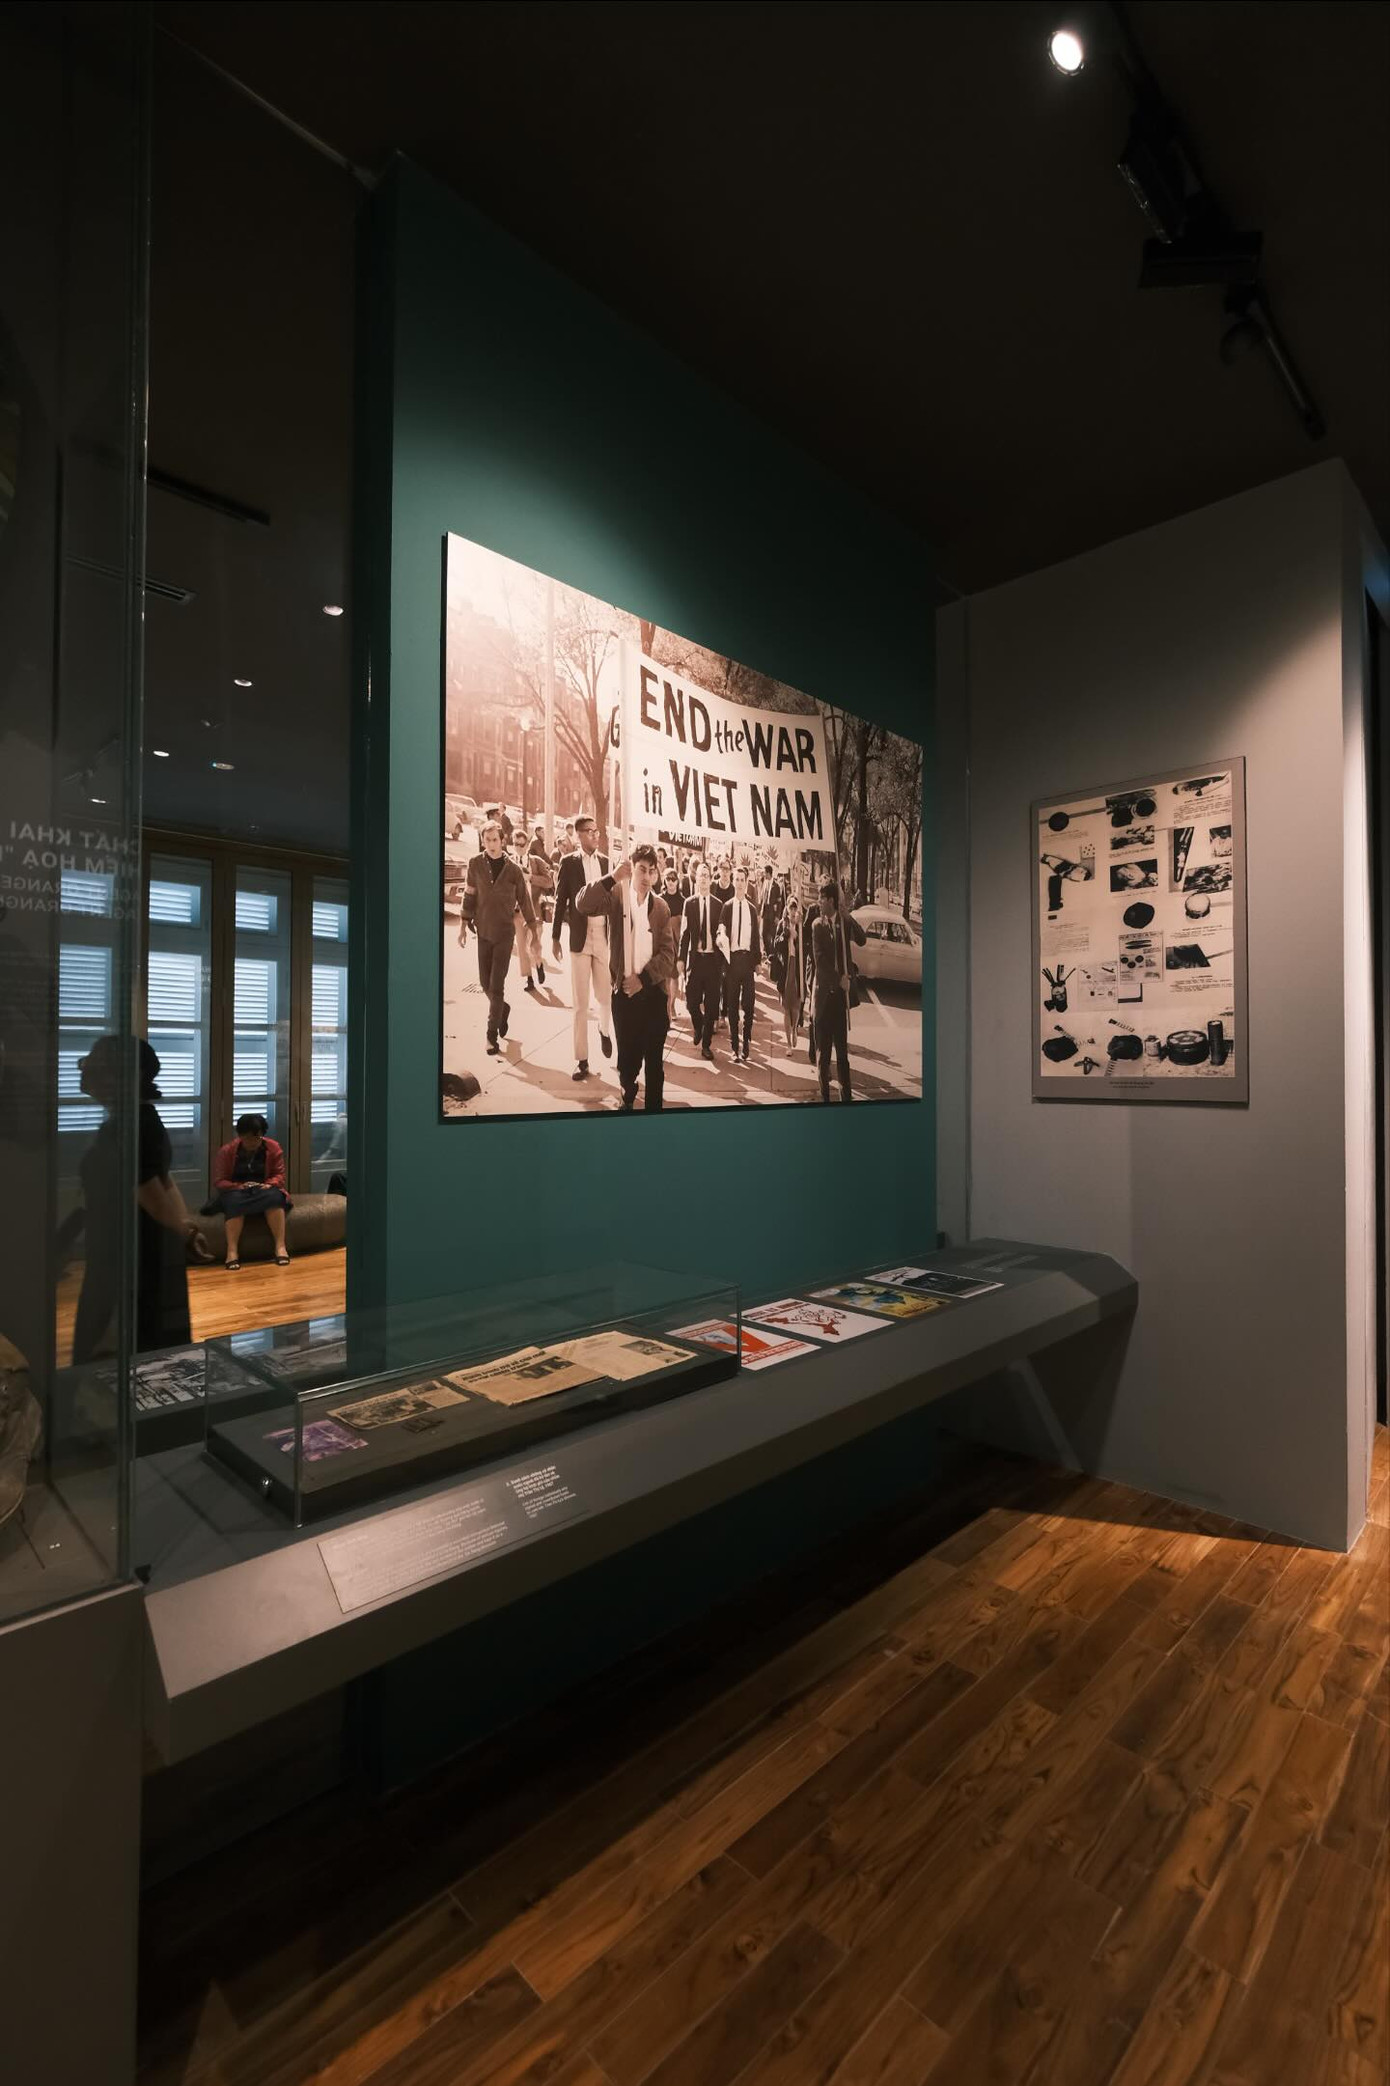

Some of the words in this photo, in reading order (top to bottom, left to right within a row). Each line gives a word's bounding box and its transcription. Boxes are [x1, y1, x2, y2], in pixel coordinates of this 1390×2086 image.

[640, 665, 711, 752] END
[714, 720, 744, 754] the
[742, 719, 817, 773] WAR
[643, 768, 662, 816] in
[669, 760, 737, 833] VIET
[750, 783, 823, 840] NAM
